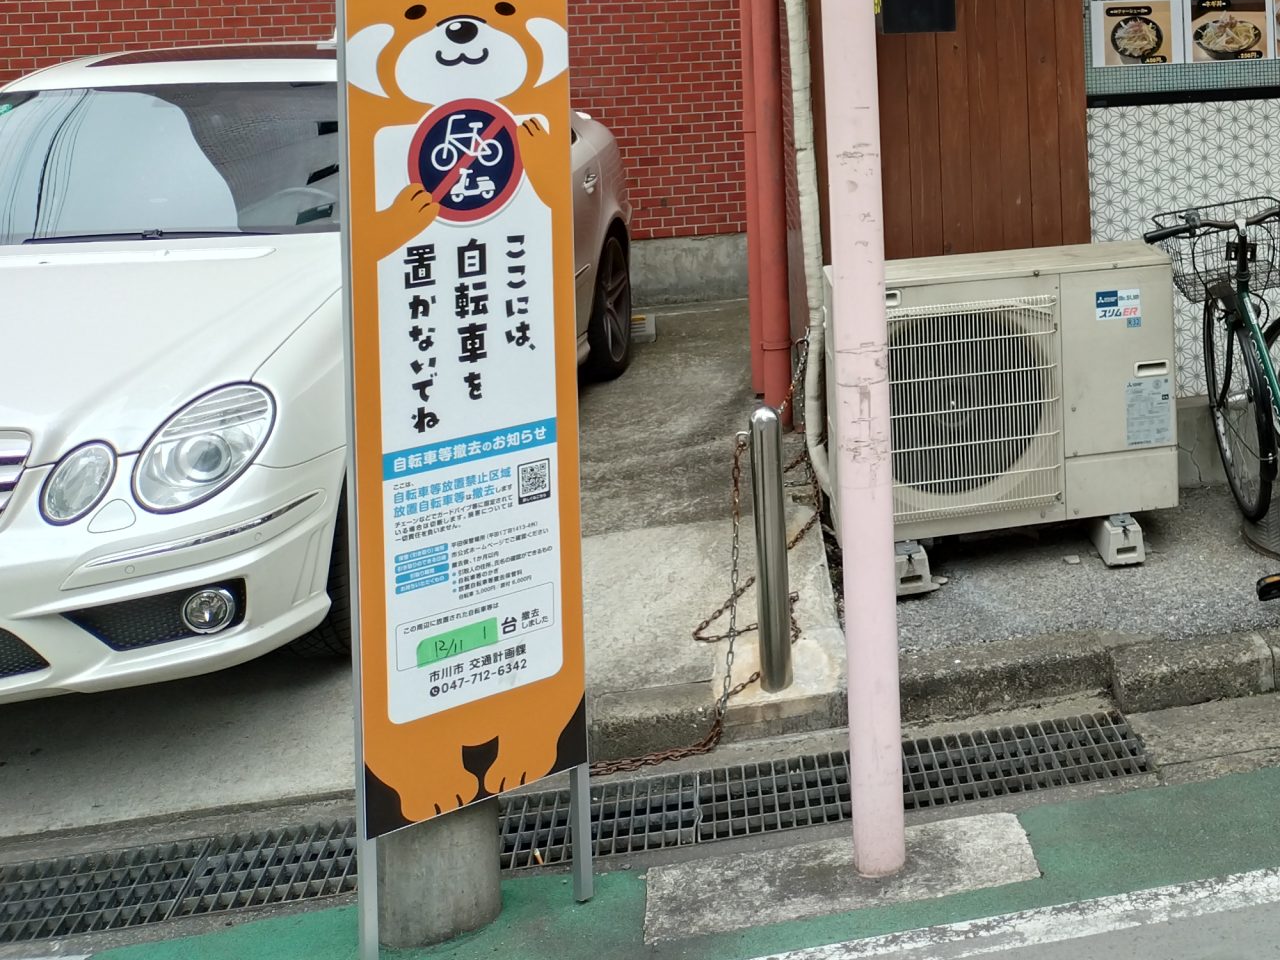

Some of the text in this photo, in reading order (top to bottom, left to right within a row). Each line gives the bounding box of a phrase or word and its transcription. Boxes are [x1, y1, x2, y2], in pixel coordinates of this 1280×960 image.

[505, 234, 537, 352] ここには、
[403, 243, 440, 434] 置かないでね
[454, 238, 489, 401] 自転車を
[393, 426, 548, 473] 自転車等撤去のお知らせ
[393, 466, 512, 505] 自転車等放置禁止区域
[393, 484, 513, 519] 放置自転車等は撤去します
[501, 616, 518, 635] 台
[521, 615, 549, 630] しました
[429, 643, 527, 683] 市川市 交通計画課
[441, 658, 527, 694] 047-712-6342
